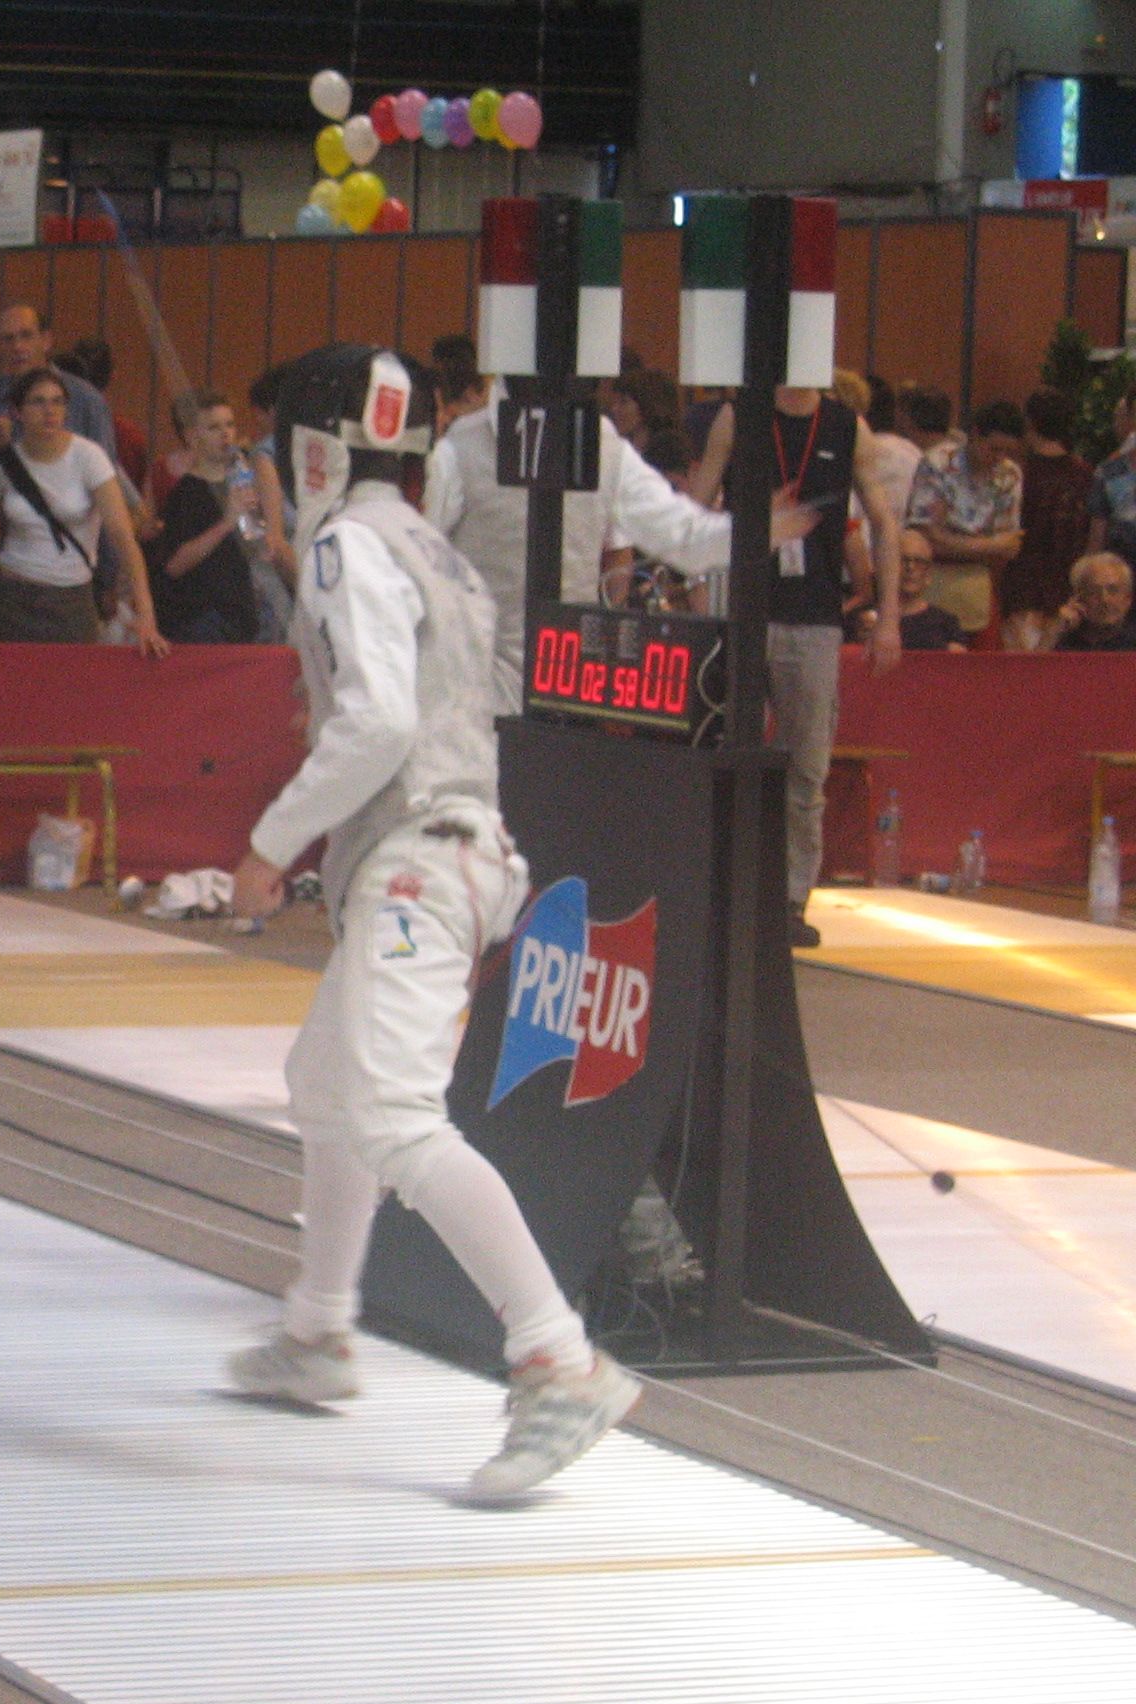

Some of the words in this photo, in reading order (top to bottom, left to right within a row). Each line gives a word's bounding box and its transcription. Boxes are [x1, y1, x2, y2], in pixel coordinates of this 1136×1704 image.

[515, 407, 546, 480] 17
[533, 627, 581, 697] 00
[580, 661, 607, 703] 02
[612, 666, 640, 709] 58
[639, 642, 692, 714] 00
[509, 936, 650, 1058] PRIEUR
